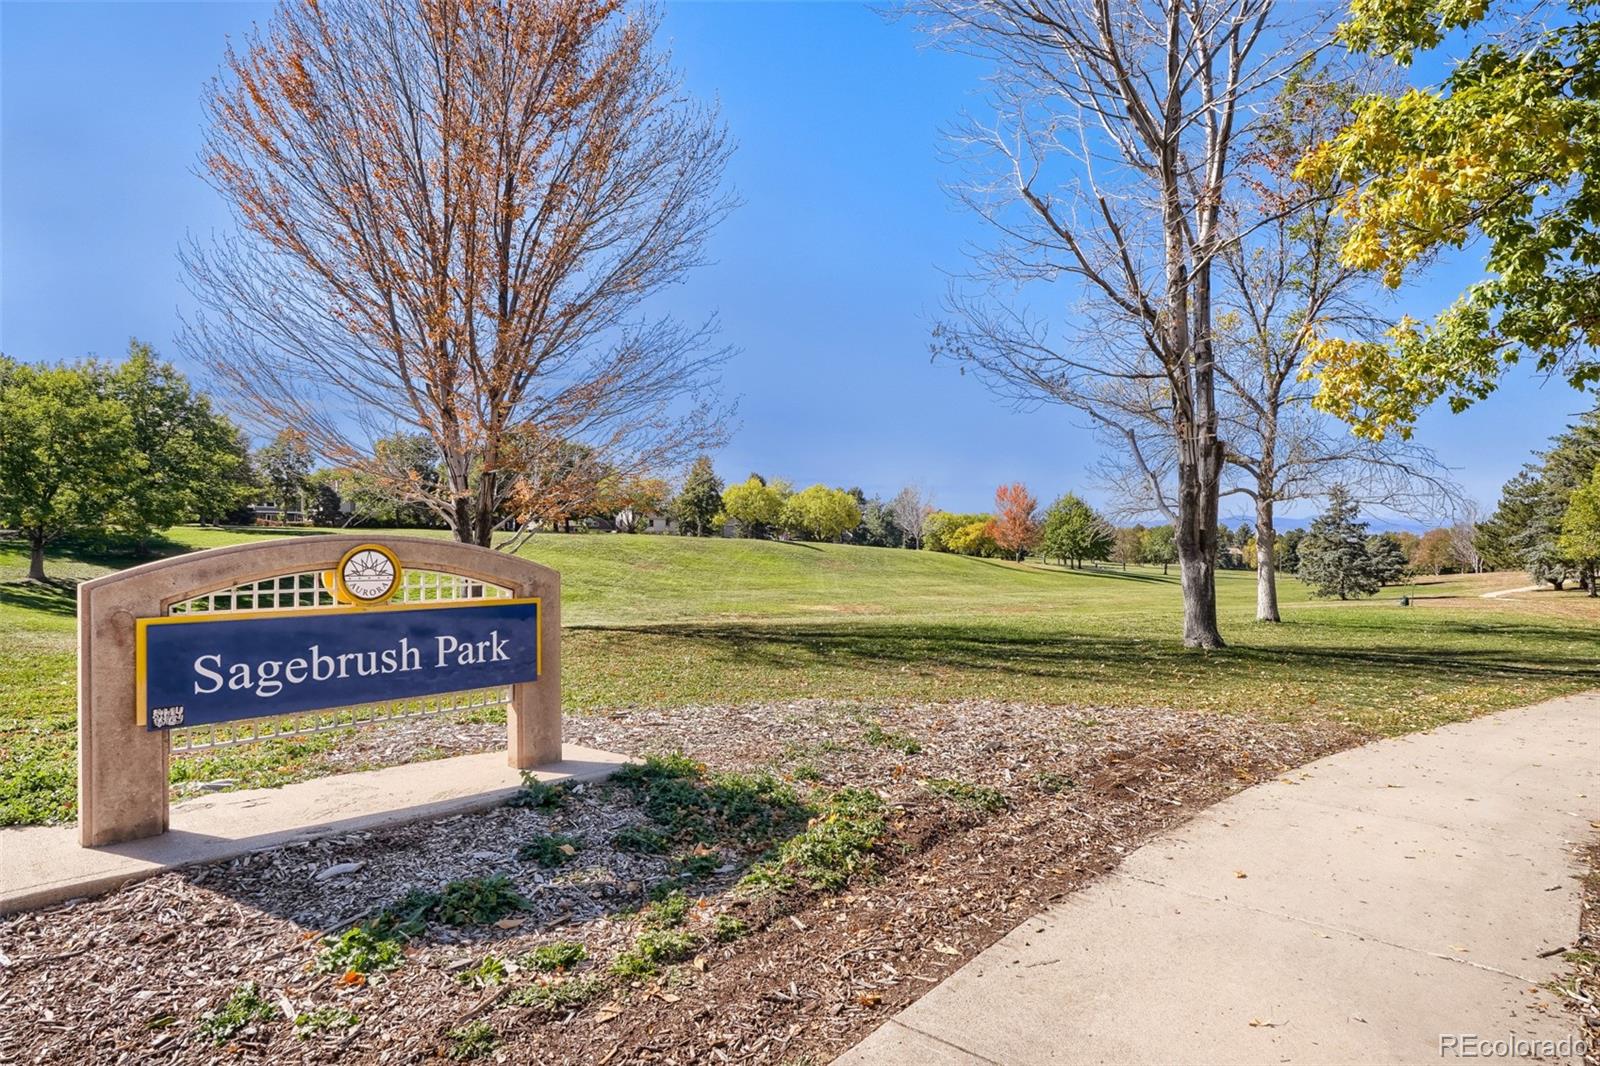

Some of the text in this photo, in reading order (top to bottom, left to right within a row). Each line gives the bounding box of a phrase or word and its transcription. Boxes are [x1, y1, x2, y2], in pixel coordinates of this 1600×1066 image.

[350, 582, 389, 596] AURORA
[193, 631, 511, 697] Sagebrush Park
